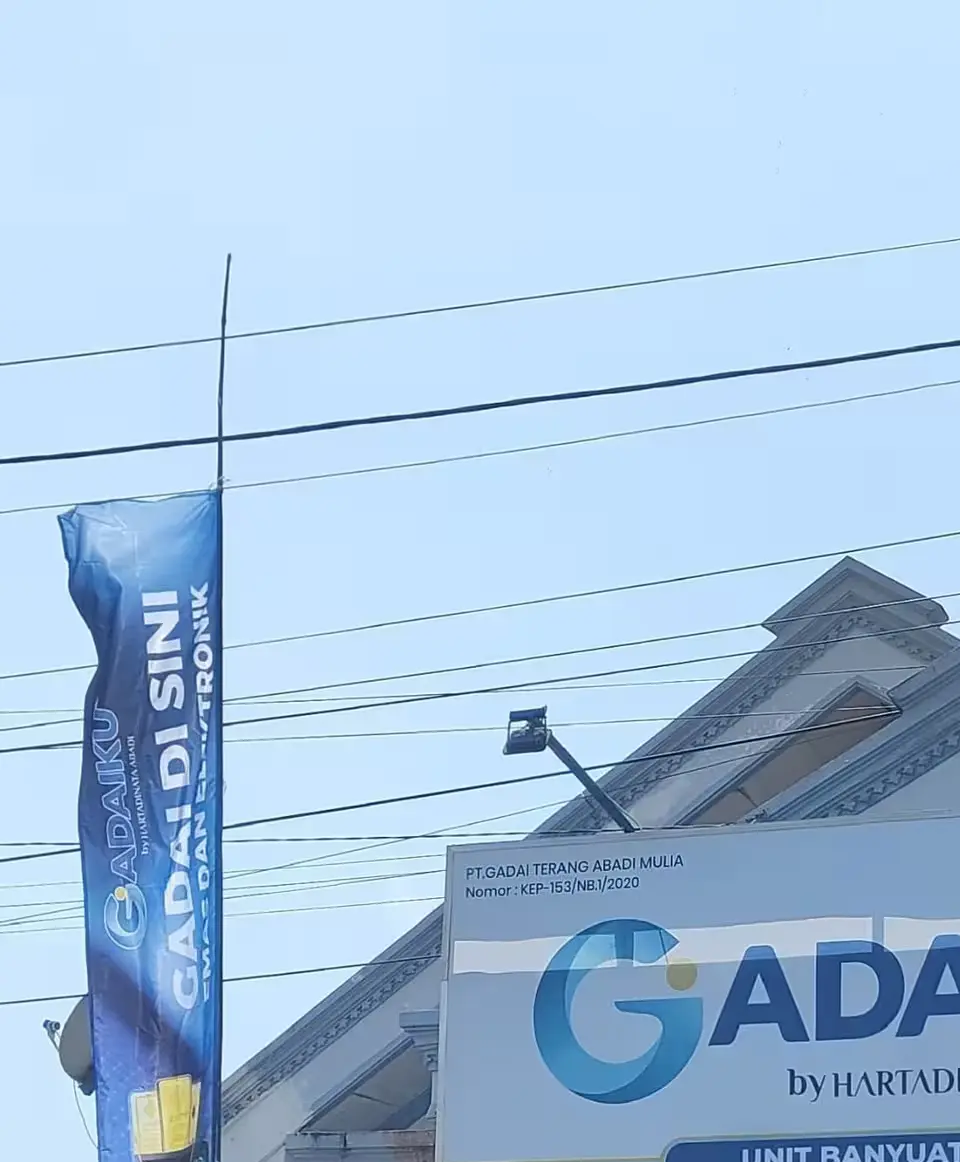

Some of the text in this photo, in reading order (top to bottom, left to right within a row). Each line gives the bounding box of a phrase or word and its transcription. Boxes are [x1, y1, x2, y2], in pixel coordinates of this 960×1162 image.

[92, 705, 148, 950] GADAIKU
[141, 590, 198, 1010] GADAI DI SINI
[194, 811, 210, 891] DAN
[466, 854, 684, 880] PT.GADAI TERANG ABADI MULIA
[465, 885, 512, 899] Nomor
[520, 876, 640, 895] KEP-153/NB.1/2020
[787, 1068, 827, 1102] by
